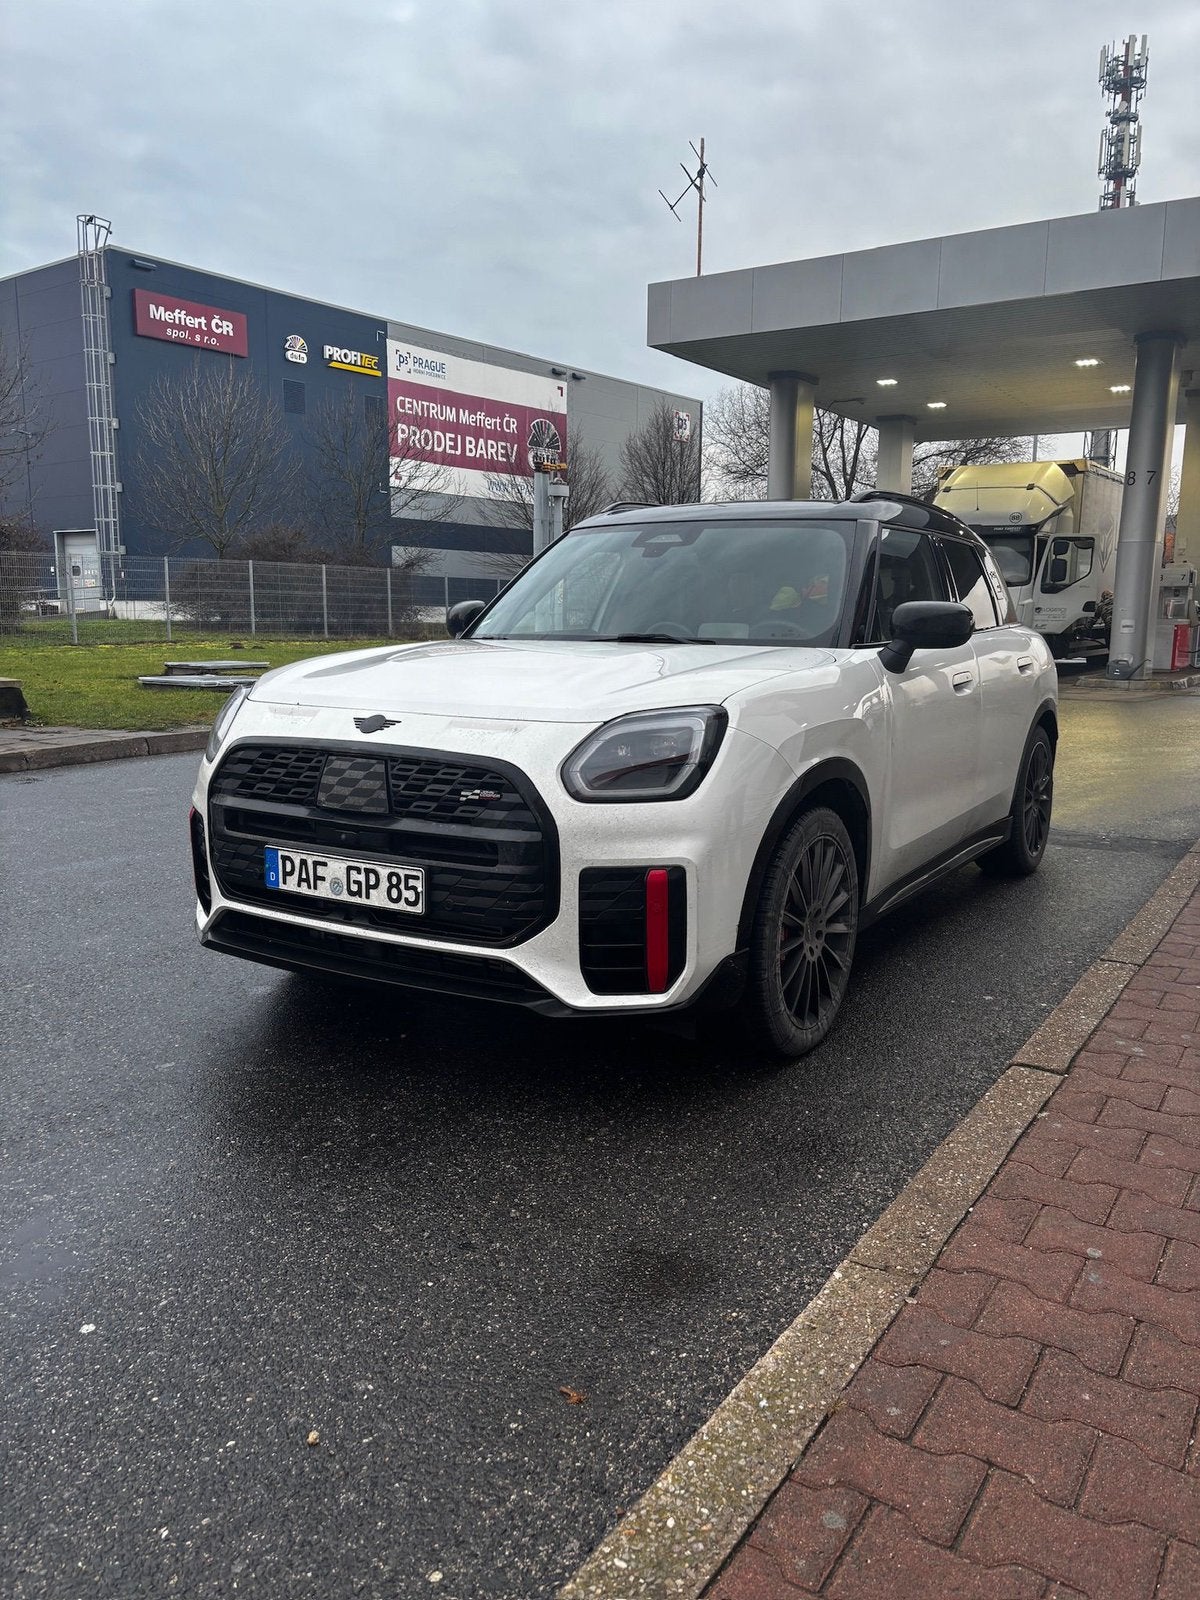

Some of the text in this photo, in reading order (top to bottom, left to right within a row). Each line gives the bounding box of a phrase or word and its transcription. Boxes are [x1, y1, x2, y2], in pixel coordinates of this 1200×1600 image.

[149, 303, 234, 336] Meffert ČR
[166, 327, 220, 346] spol. s r.o.
[412, 355, 447, 374] PRAGUE
[396, 396, 518, 434] CENTRUM Meffert ČR
[397, 423, 461, 455] PRODEJ
[465, 436, 518, 463] BAREV
[1126, 470, 1157, 486] 8 7
[270, 871, 276, 881] D
[280, 854, 420, 907] PAF GP 85
